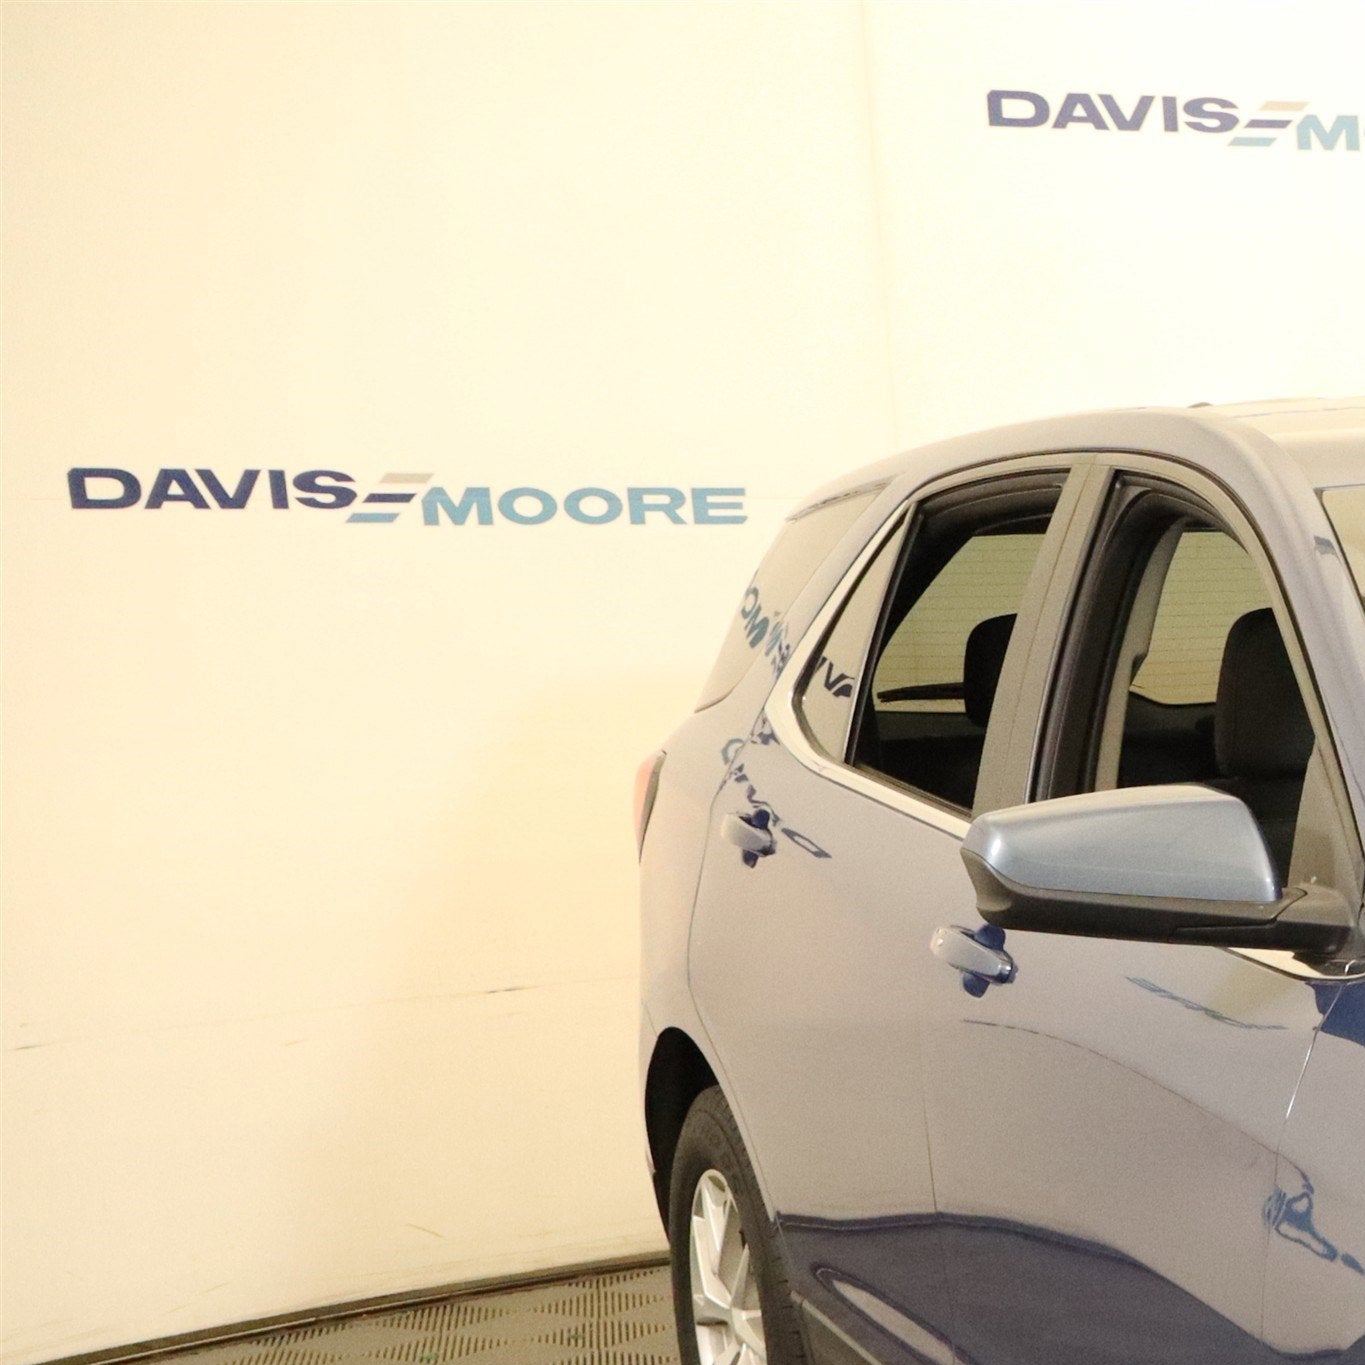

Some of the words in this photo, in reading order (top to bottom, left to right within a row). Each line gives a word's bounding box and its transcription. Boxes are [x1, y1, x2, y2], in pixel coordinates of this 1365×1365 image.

[986, 89, 1239, 134] DAVIS
[67, 468, 358, 511] DAVIS
[421, 486, 747, 527] MOORE
